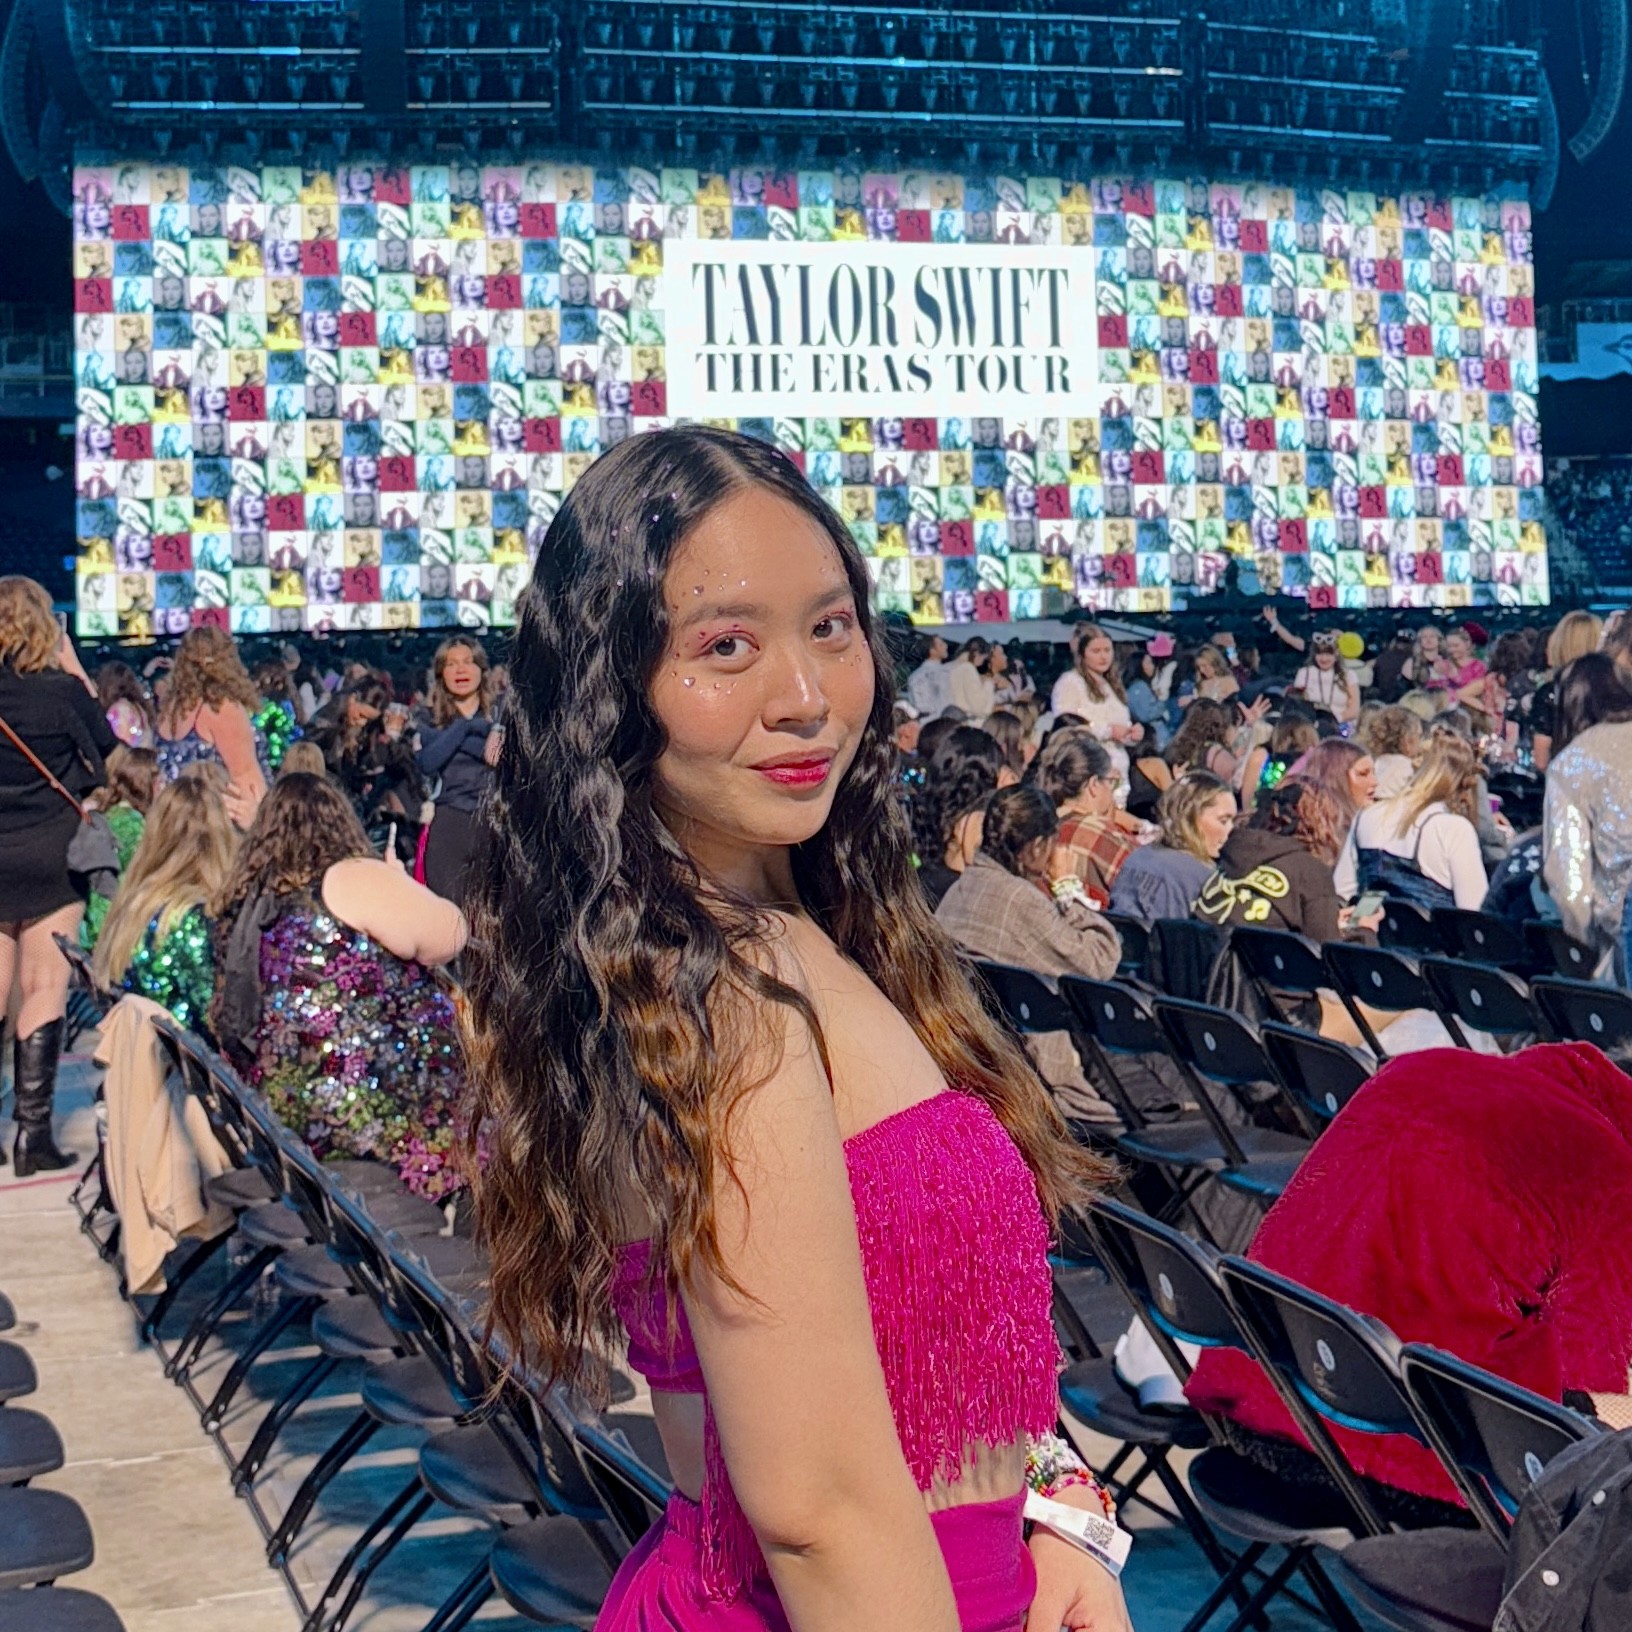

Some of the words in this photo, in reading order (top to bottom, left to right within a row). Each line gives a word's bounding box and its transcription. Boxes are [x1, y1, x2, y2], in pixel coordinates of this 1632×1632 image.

[691, 263, 899, 347] TAYLOR
[913, 265, 1069, 348] SWIFT
[695, 353, 796, 393] THE
[812, 354, 933, 393] ERAS
[945, 354, 1072, 394] TOUR
